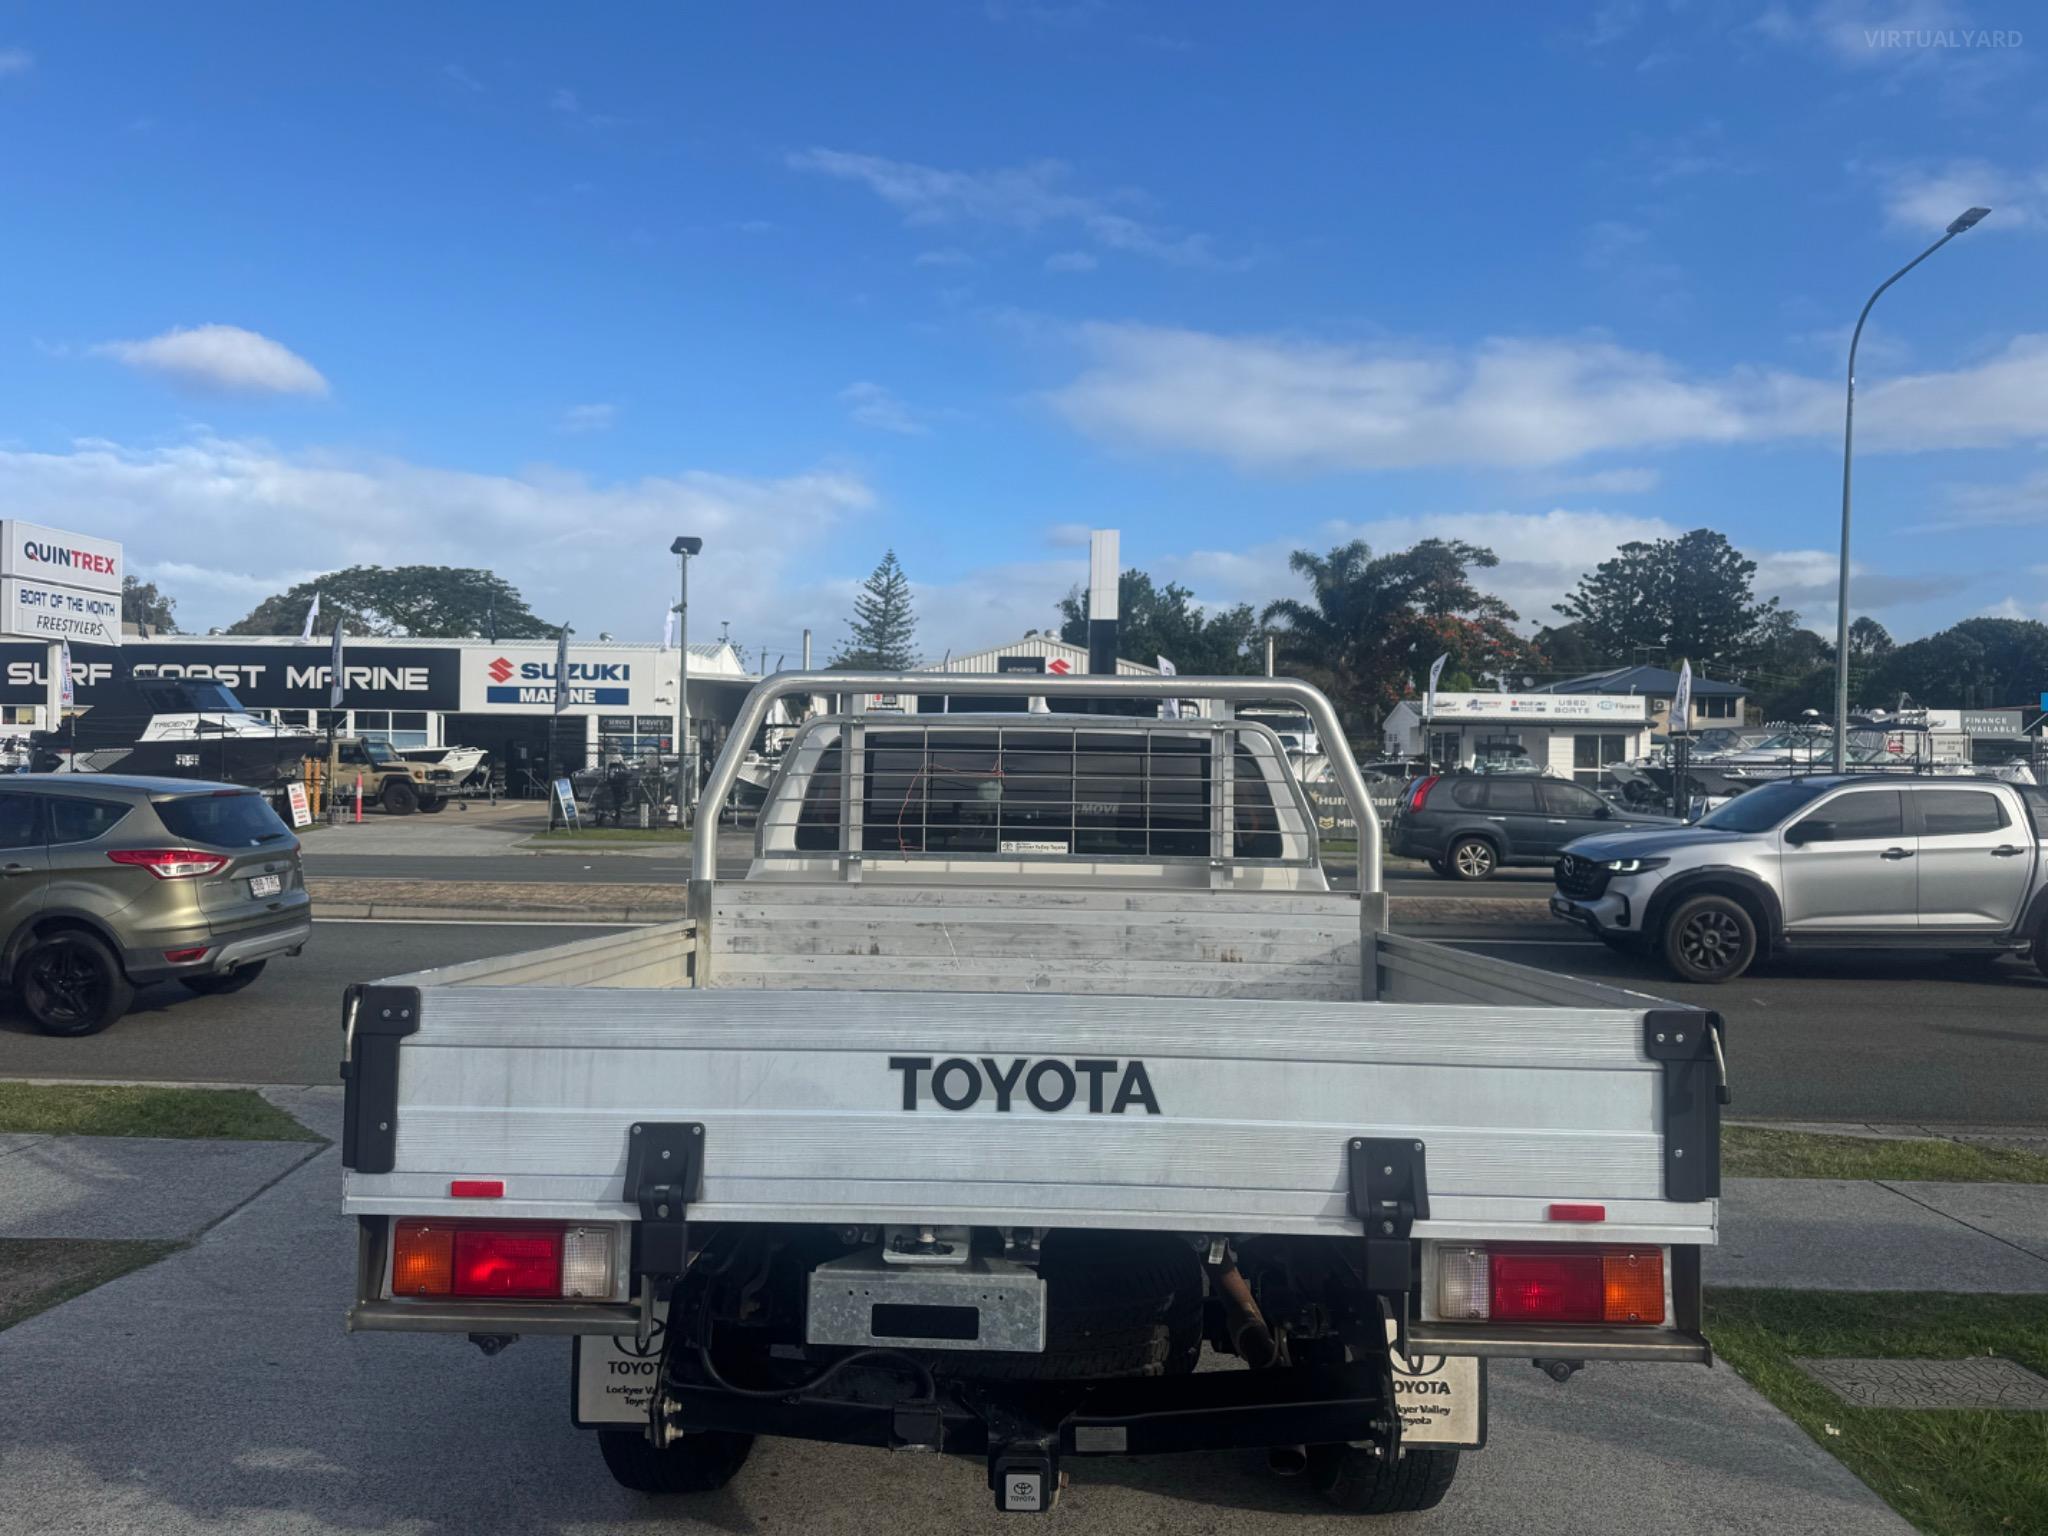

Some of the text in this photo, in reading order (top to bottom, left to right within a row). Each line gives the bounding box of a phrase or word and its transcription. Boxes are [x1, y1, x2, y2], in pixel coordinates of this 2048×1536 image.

[24, 541, 115, 575] QUINTREX
[20, 588, 116, 617] BOAT OF THE MONTH
[37, 614, 104, 636] FREESTYLERS
[520, 662, 631, 681] SUZUKI
[889, 1056, 1162, 1115] TOYOTA
[1393, 1380, 1452, 1395] OYOTA
